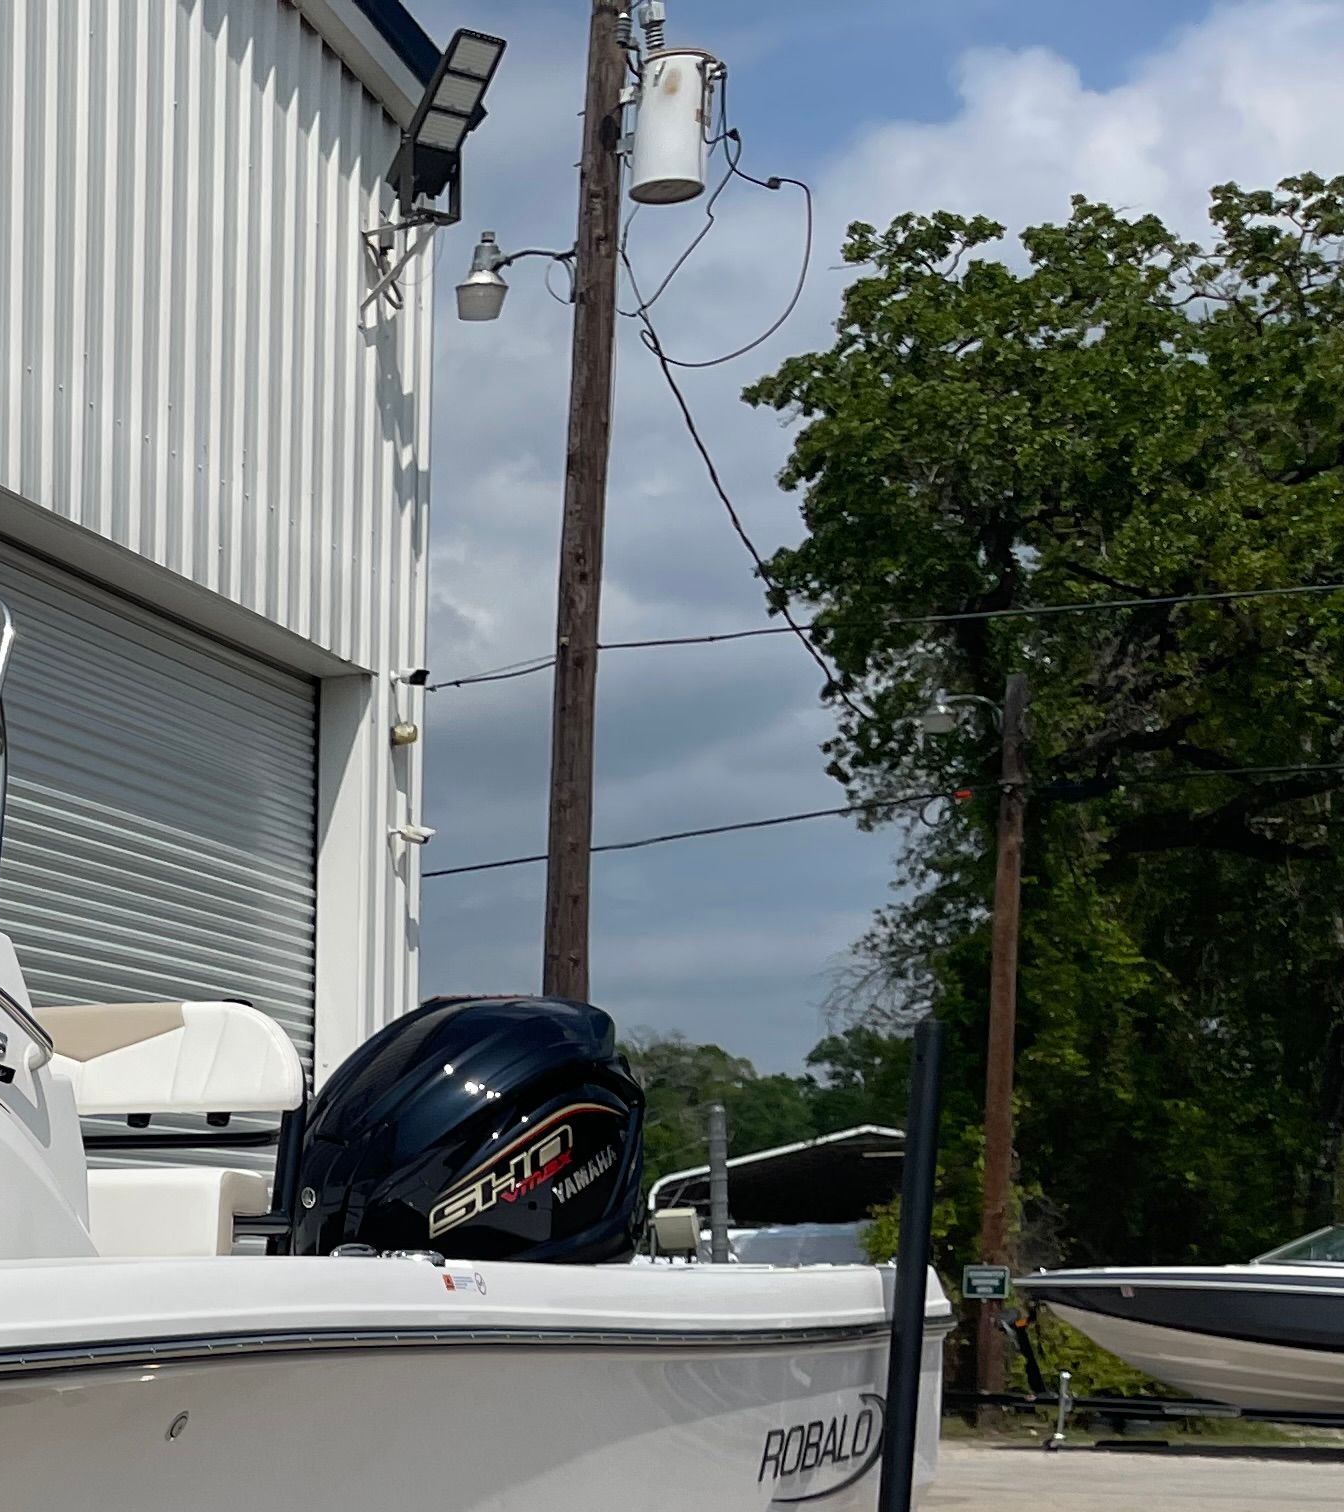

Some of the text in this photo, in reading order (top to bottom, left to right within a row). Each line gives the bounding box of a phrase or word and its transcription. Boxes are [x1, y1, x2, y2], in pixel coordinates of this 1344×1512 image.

[428, 1123, 573, 1240] SHO
[552, 1144, 618, 1204] YAMAHA
[757, 1409, 873, 1482] ROBALO
